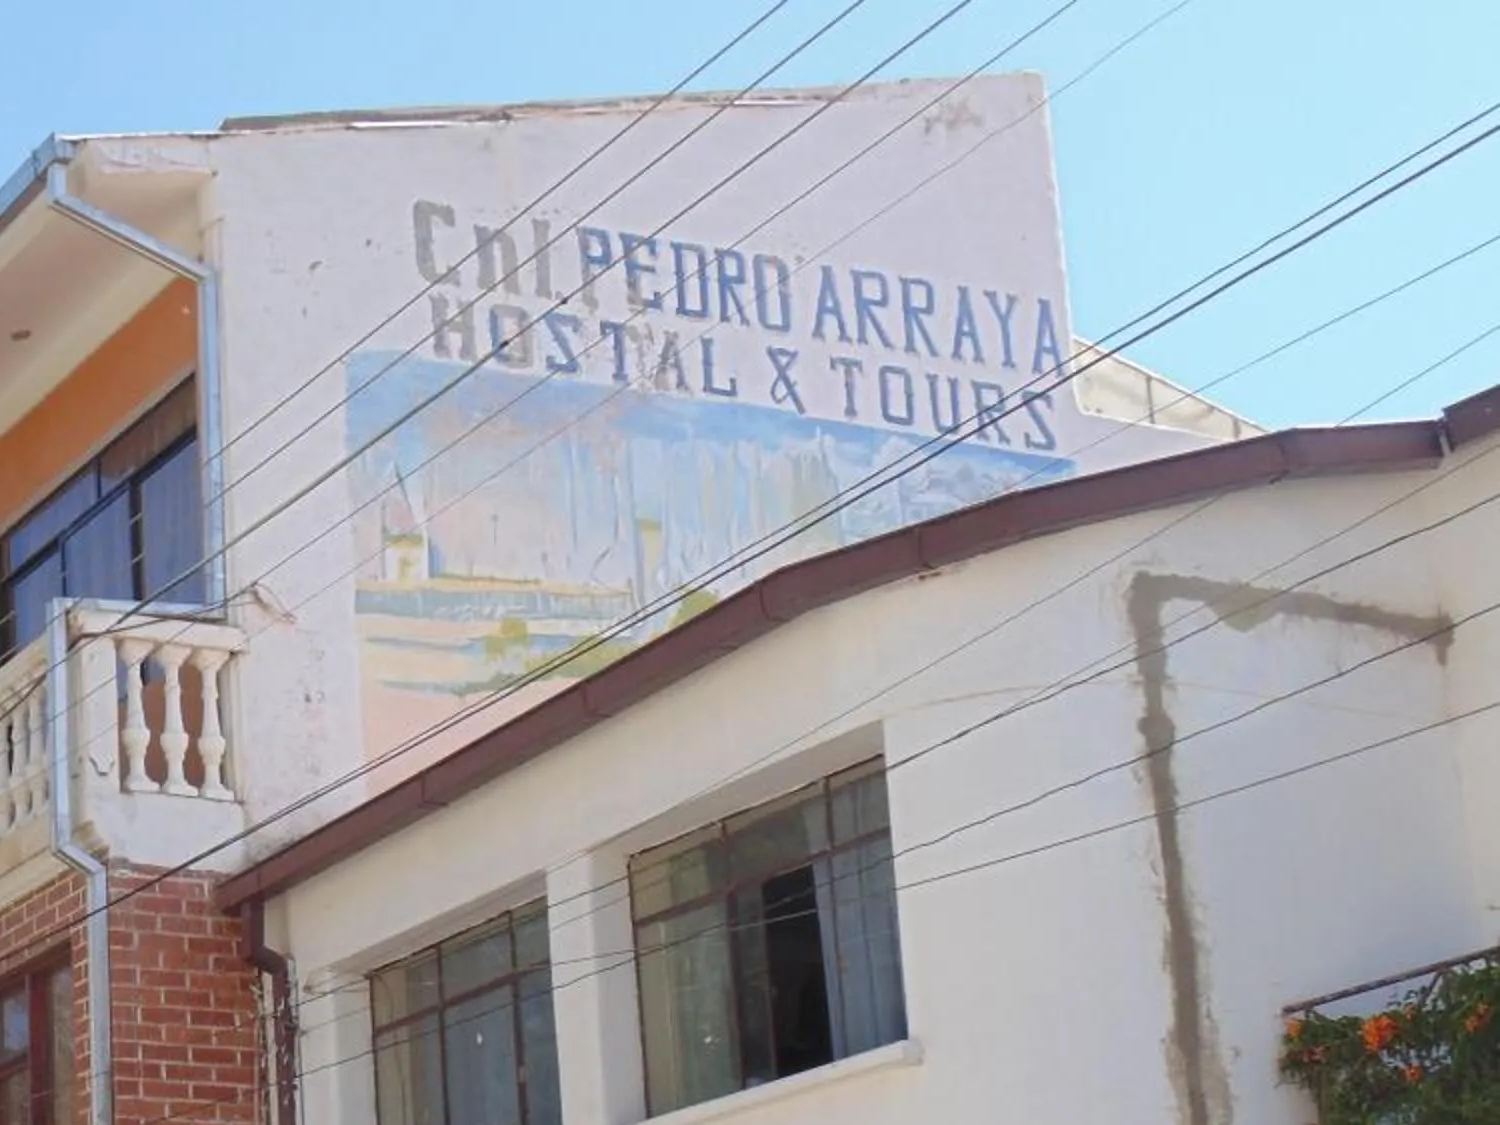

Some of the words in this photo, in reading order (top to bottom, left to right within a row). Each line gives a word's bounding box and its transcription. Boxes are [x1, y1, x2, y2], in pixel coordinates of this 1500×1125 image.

[428, 291, 737, 397] HOSTAL
[766, 345, 806, 414] &
[829, 355, 1056, 451] TOURS
[574, 225, 793, 335] PEDRO
[811, 265, 1063, 378] ARRAYA
